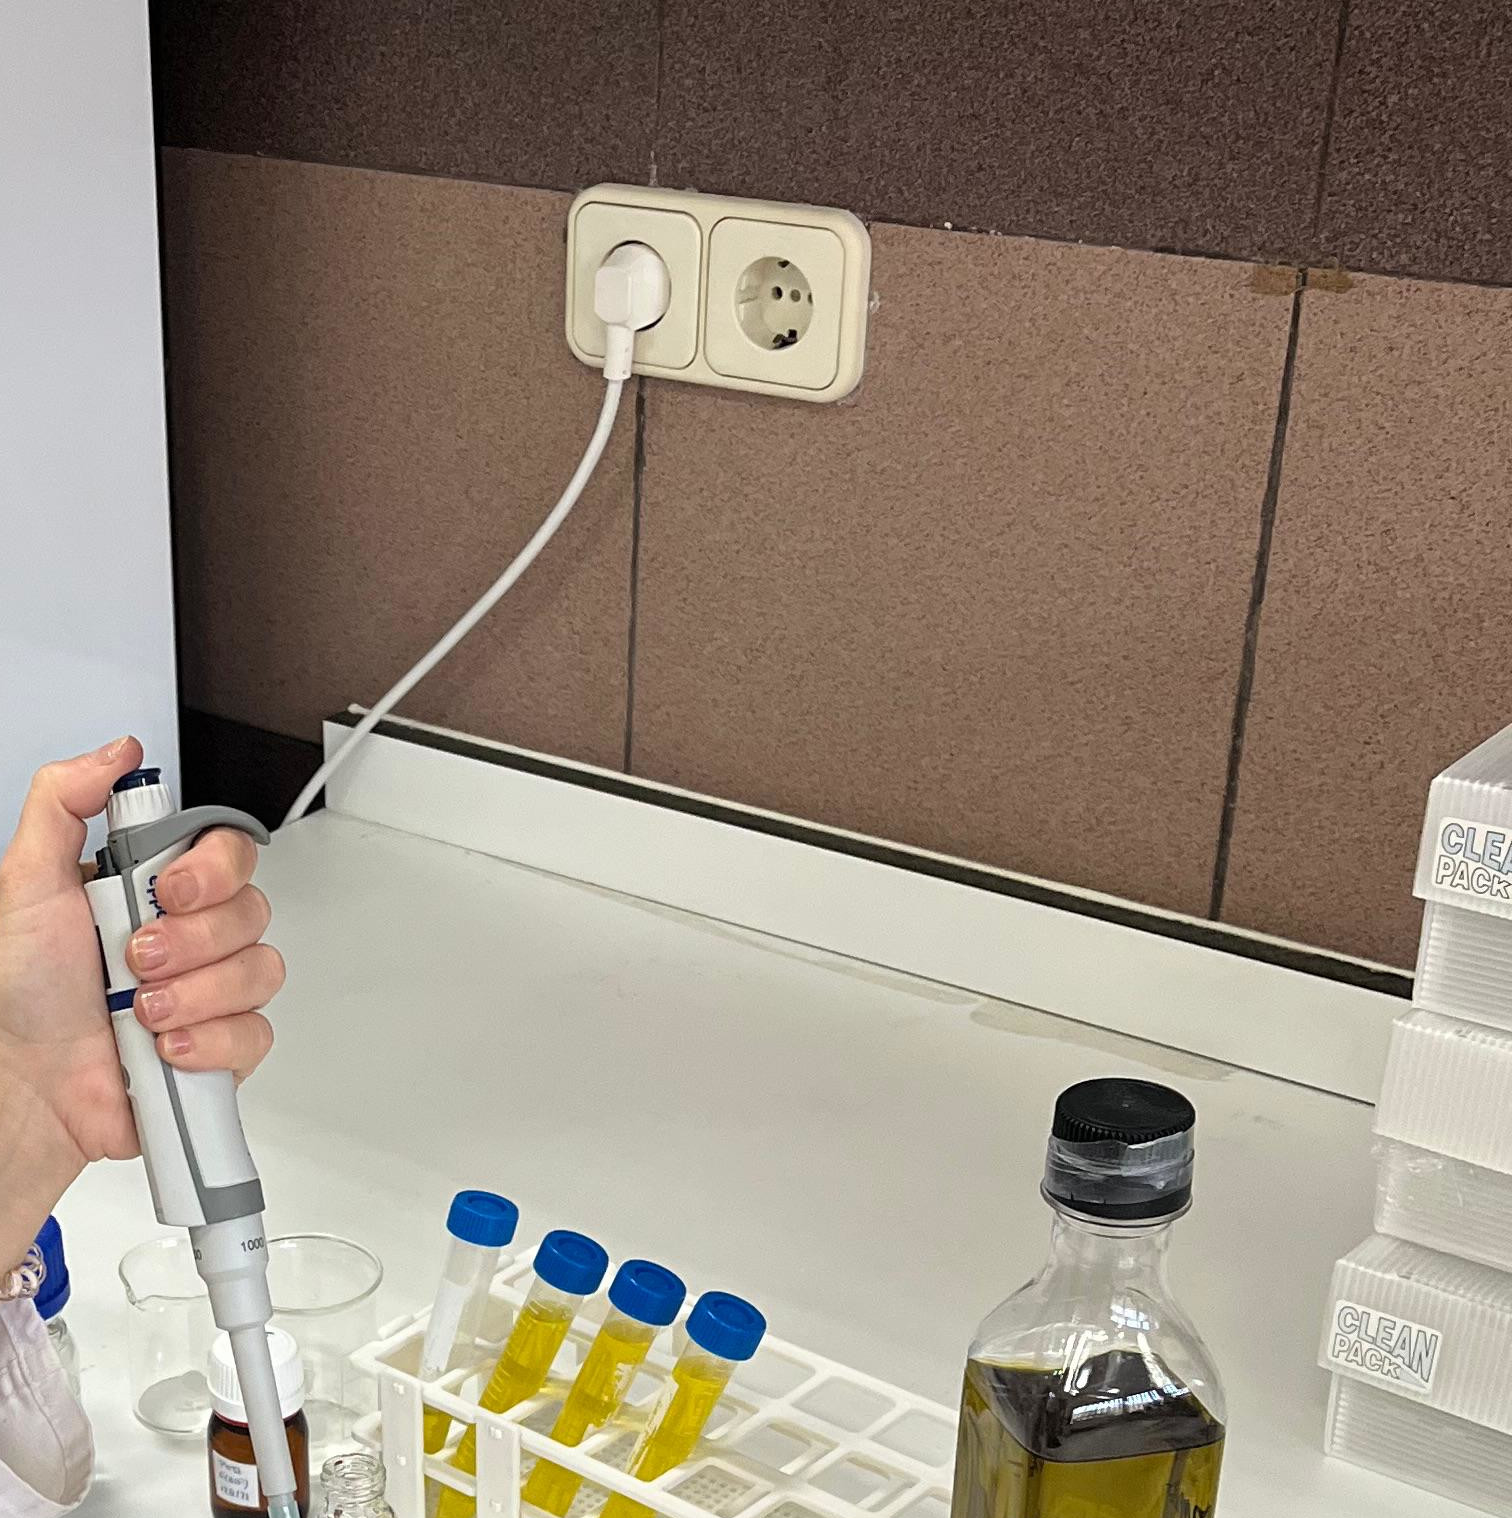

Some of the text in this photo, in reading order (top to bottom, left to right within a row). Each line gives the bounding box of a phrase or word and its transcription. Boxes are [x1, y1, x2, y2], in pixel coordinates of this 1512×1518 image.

[1435, 854, 1512, 899] PACK
[1332, 1333, 1402, 1380] PACK
[1337, 1306, 1439, 1383] CLEAN
